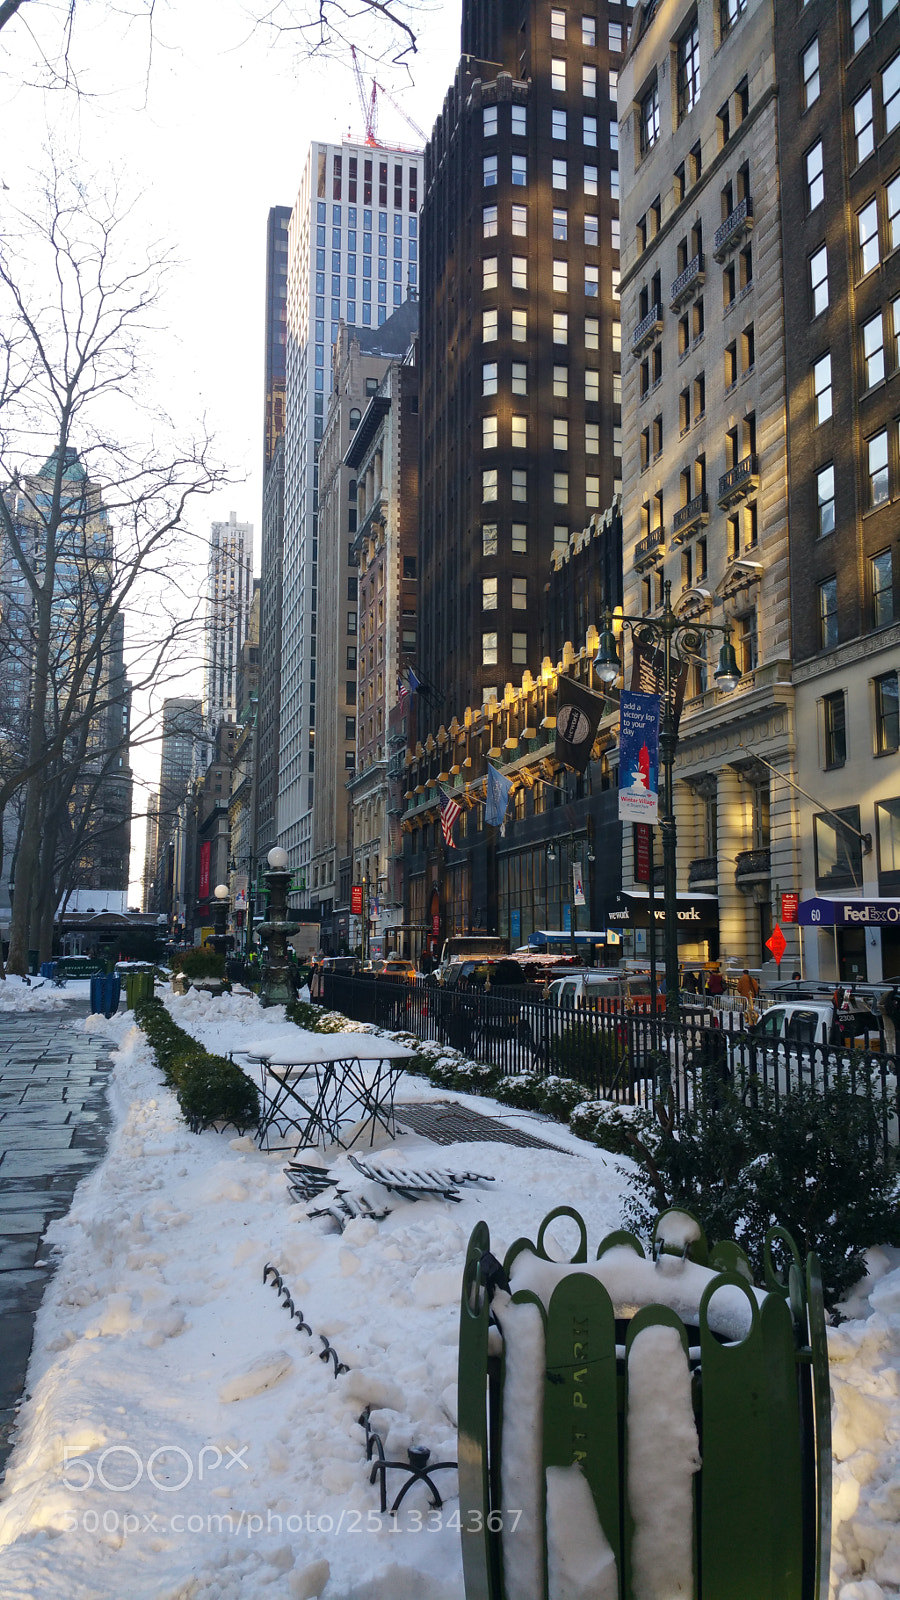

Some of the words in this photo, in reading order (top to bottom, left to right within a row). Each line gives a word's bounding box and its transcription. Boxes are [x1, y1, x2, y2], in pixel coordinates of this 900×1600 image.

[623, 711, 645, 721] victory
[645, 713, 656, 722] lap
[632, 721, 646, 729] your
[622, 727, 635, 737] day
[639, 798, 656, 807] Village
[608, 906, 630, 920] wework
[647, 906, 701, 920] weork
[811, 909, 821, 922] 60
[844, 906, 887, 922] FedEx
[887, 907, 900, 922] O
[572, 1316, 590, 1409] PARK
